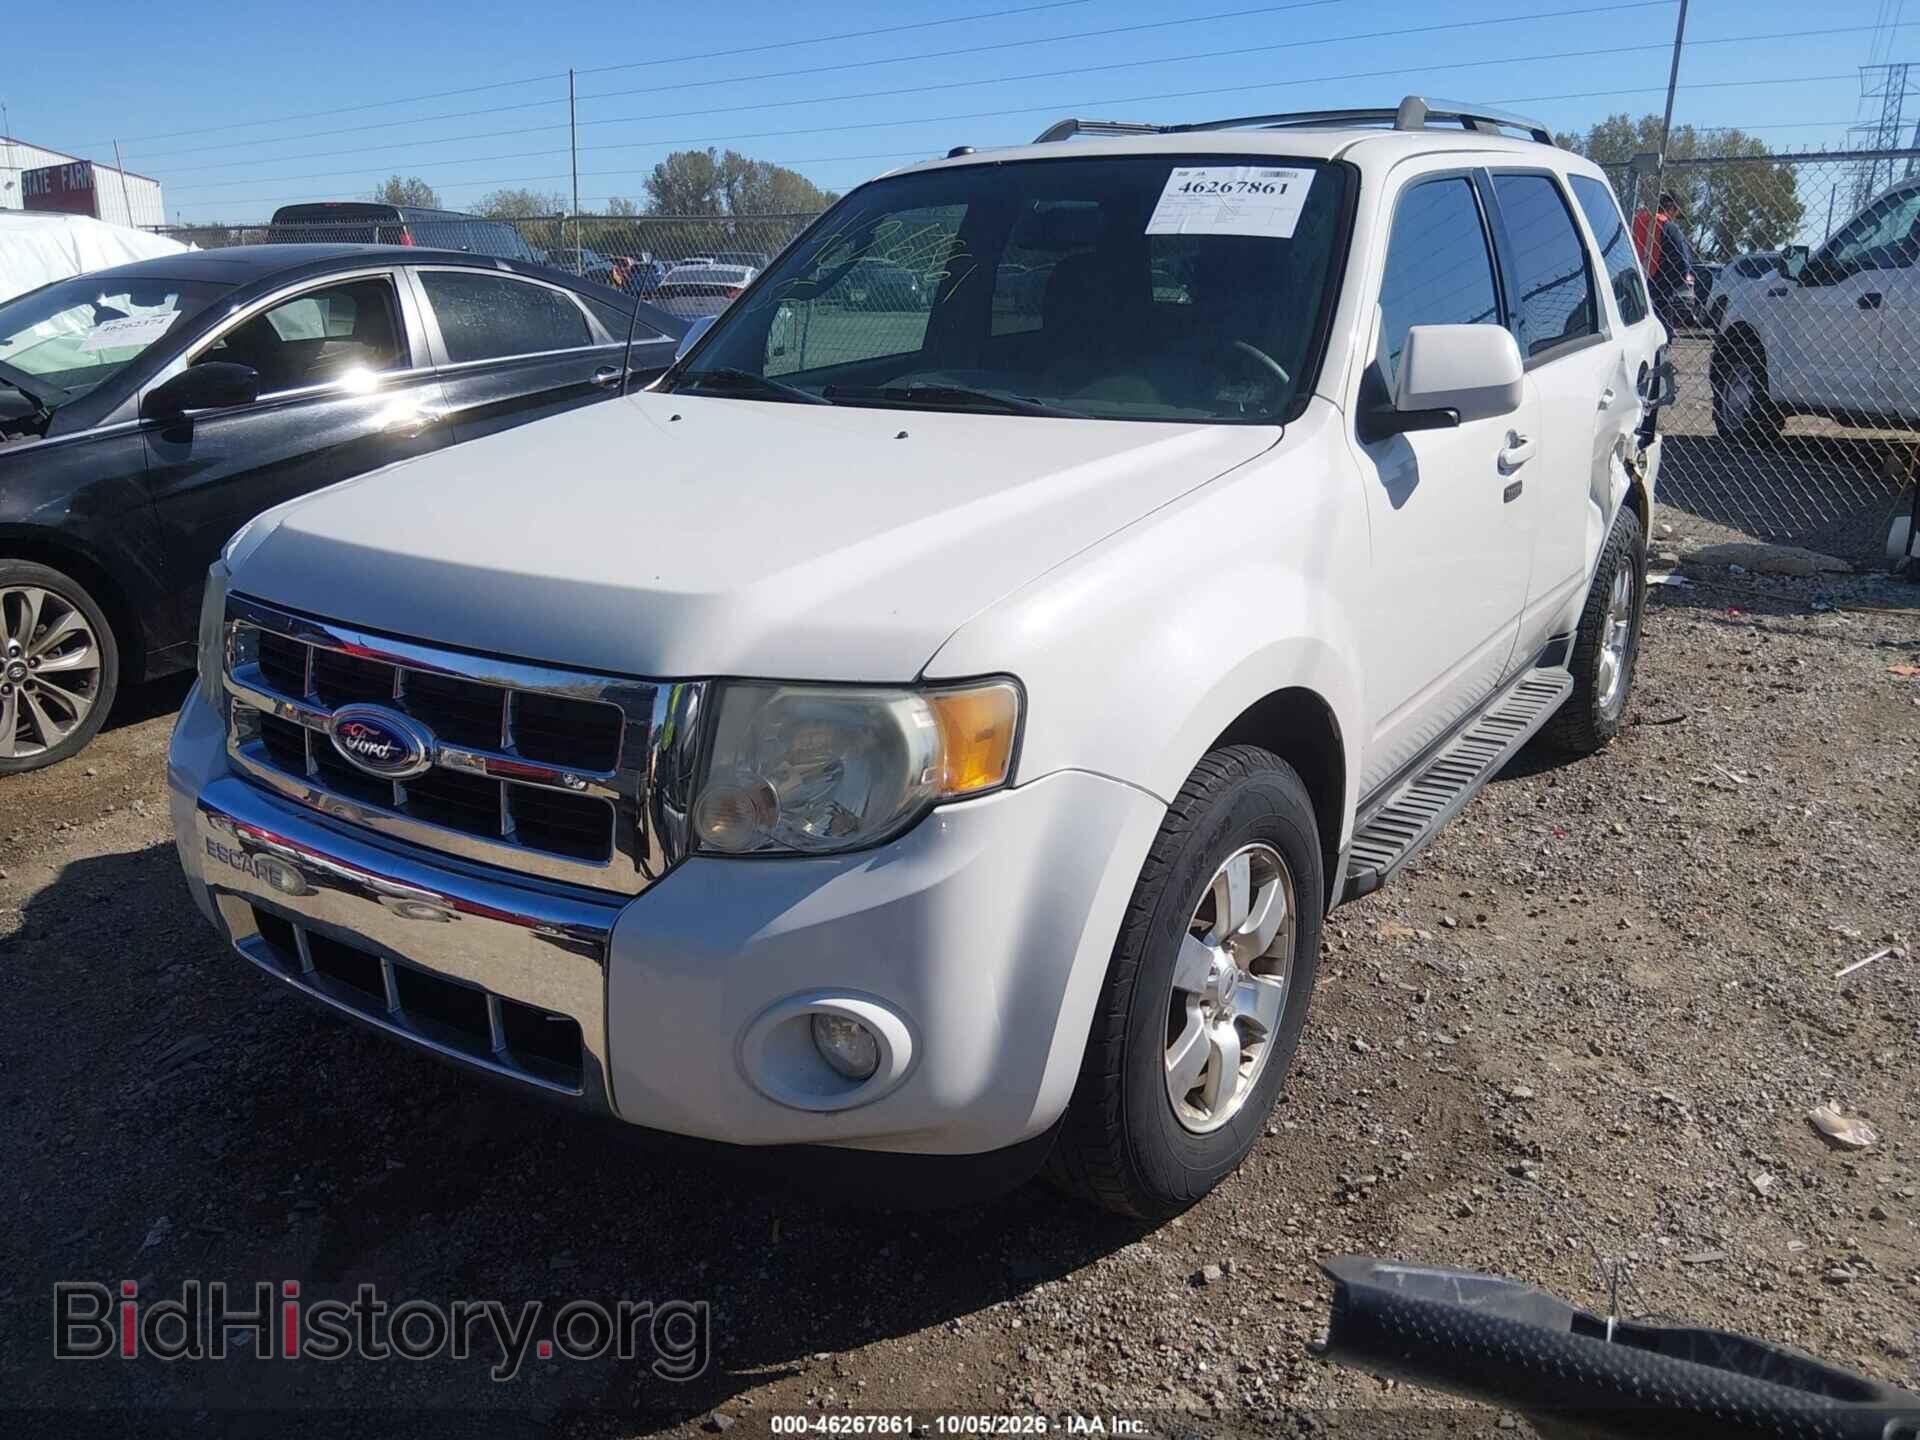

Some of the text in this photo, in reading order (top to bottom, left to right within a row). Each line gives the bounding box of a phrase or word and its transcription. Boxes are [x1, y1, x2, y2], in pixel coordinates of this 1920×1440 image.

[22, 169, 51, 196] STATE
[1178, 181, 1289, 195] 46267861
[344, 723, 392, 760] Ford
[205, 836, 283, 890] ESCAPE
